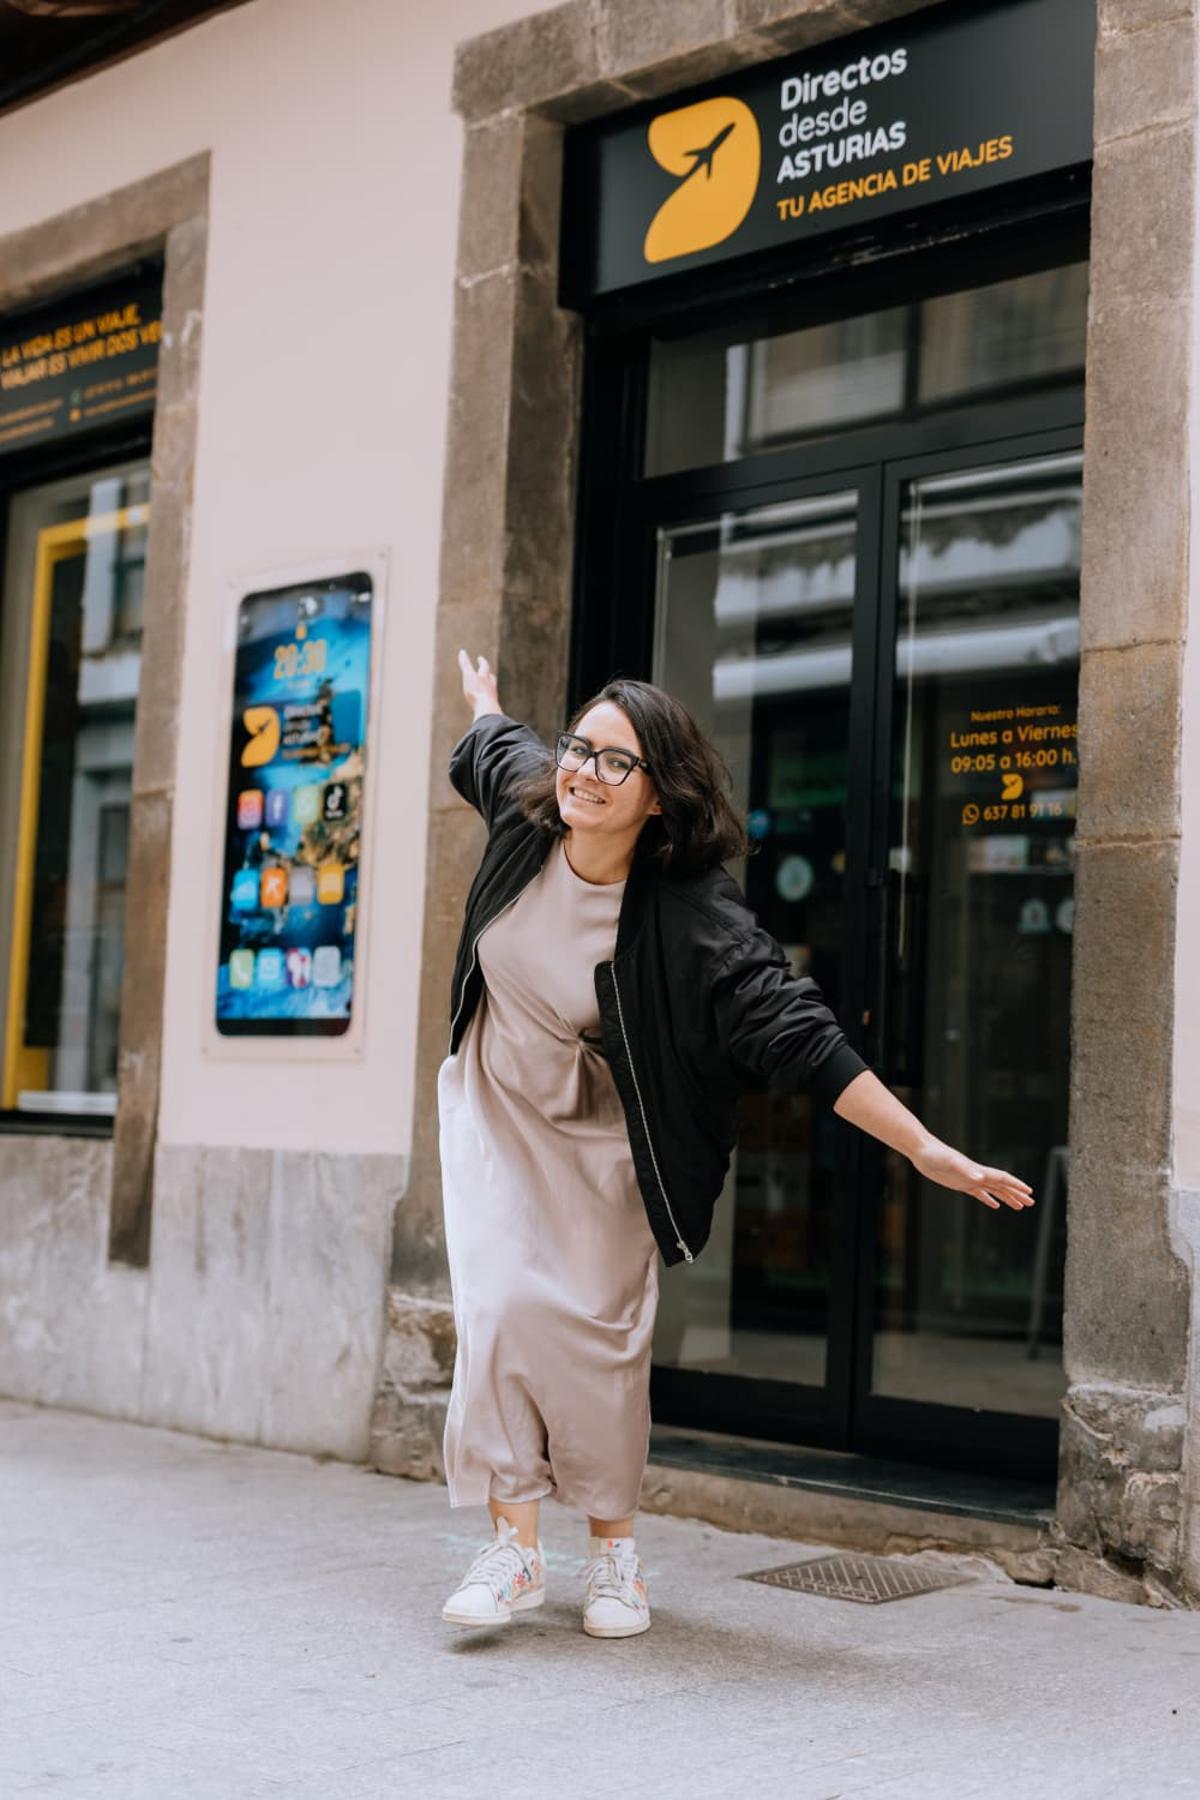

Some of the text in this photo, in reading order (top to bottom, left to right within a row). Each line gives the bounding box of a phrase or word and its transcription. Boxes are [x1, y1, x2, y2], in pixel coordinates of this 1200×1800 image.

[780, 48, 907, 111] Directos
[778, 97, 867, 147] desde
[776, 121, 907, 184] ASTURIAS
[777, 136, 1013, 220] TU AGENCIA DE VIAJES
[971, 710, 1013, 721] Nuestro
[950, 723, 1079, 748] Lunes a Viernes
[951, 753, 996, 773] 09:05
[1000, 755, 1011, 768] a
[1015, 748, 1058, 767] 16:00
[983, 805, 1009, 821] 637
[1011, 804, 1026, 819] 81
